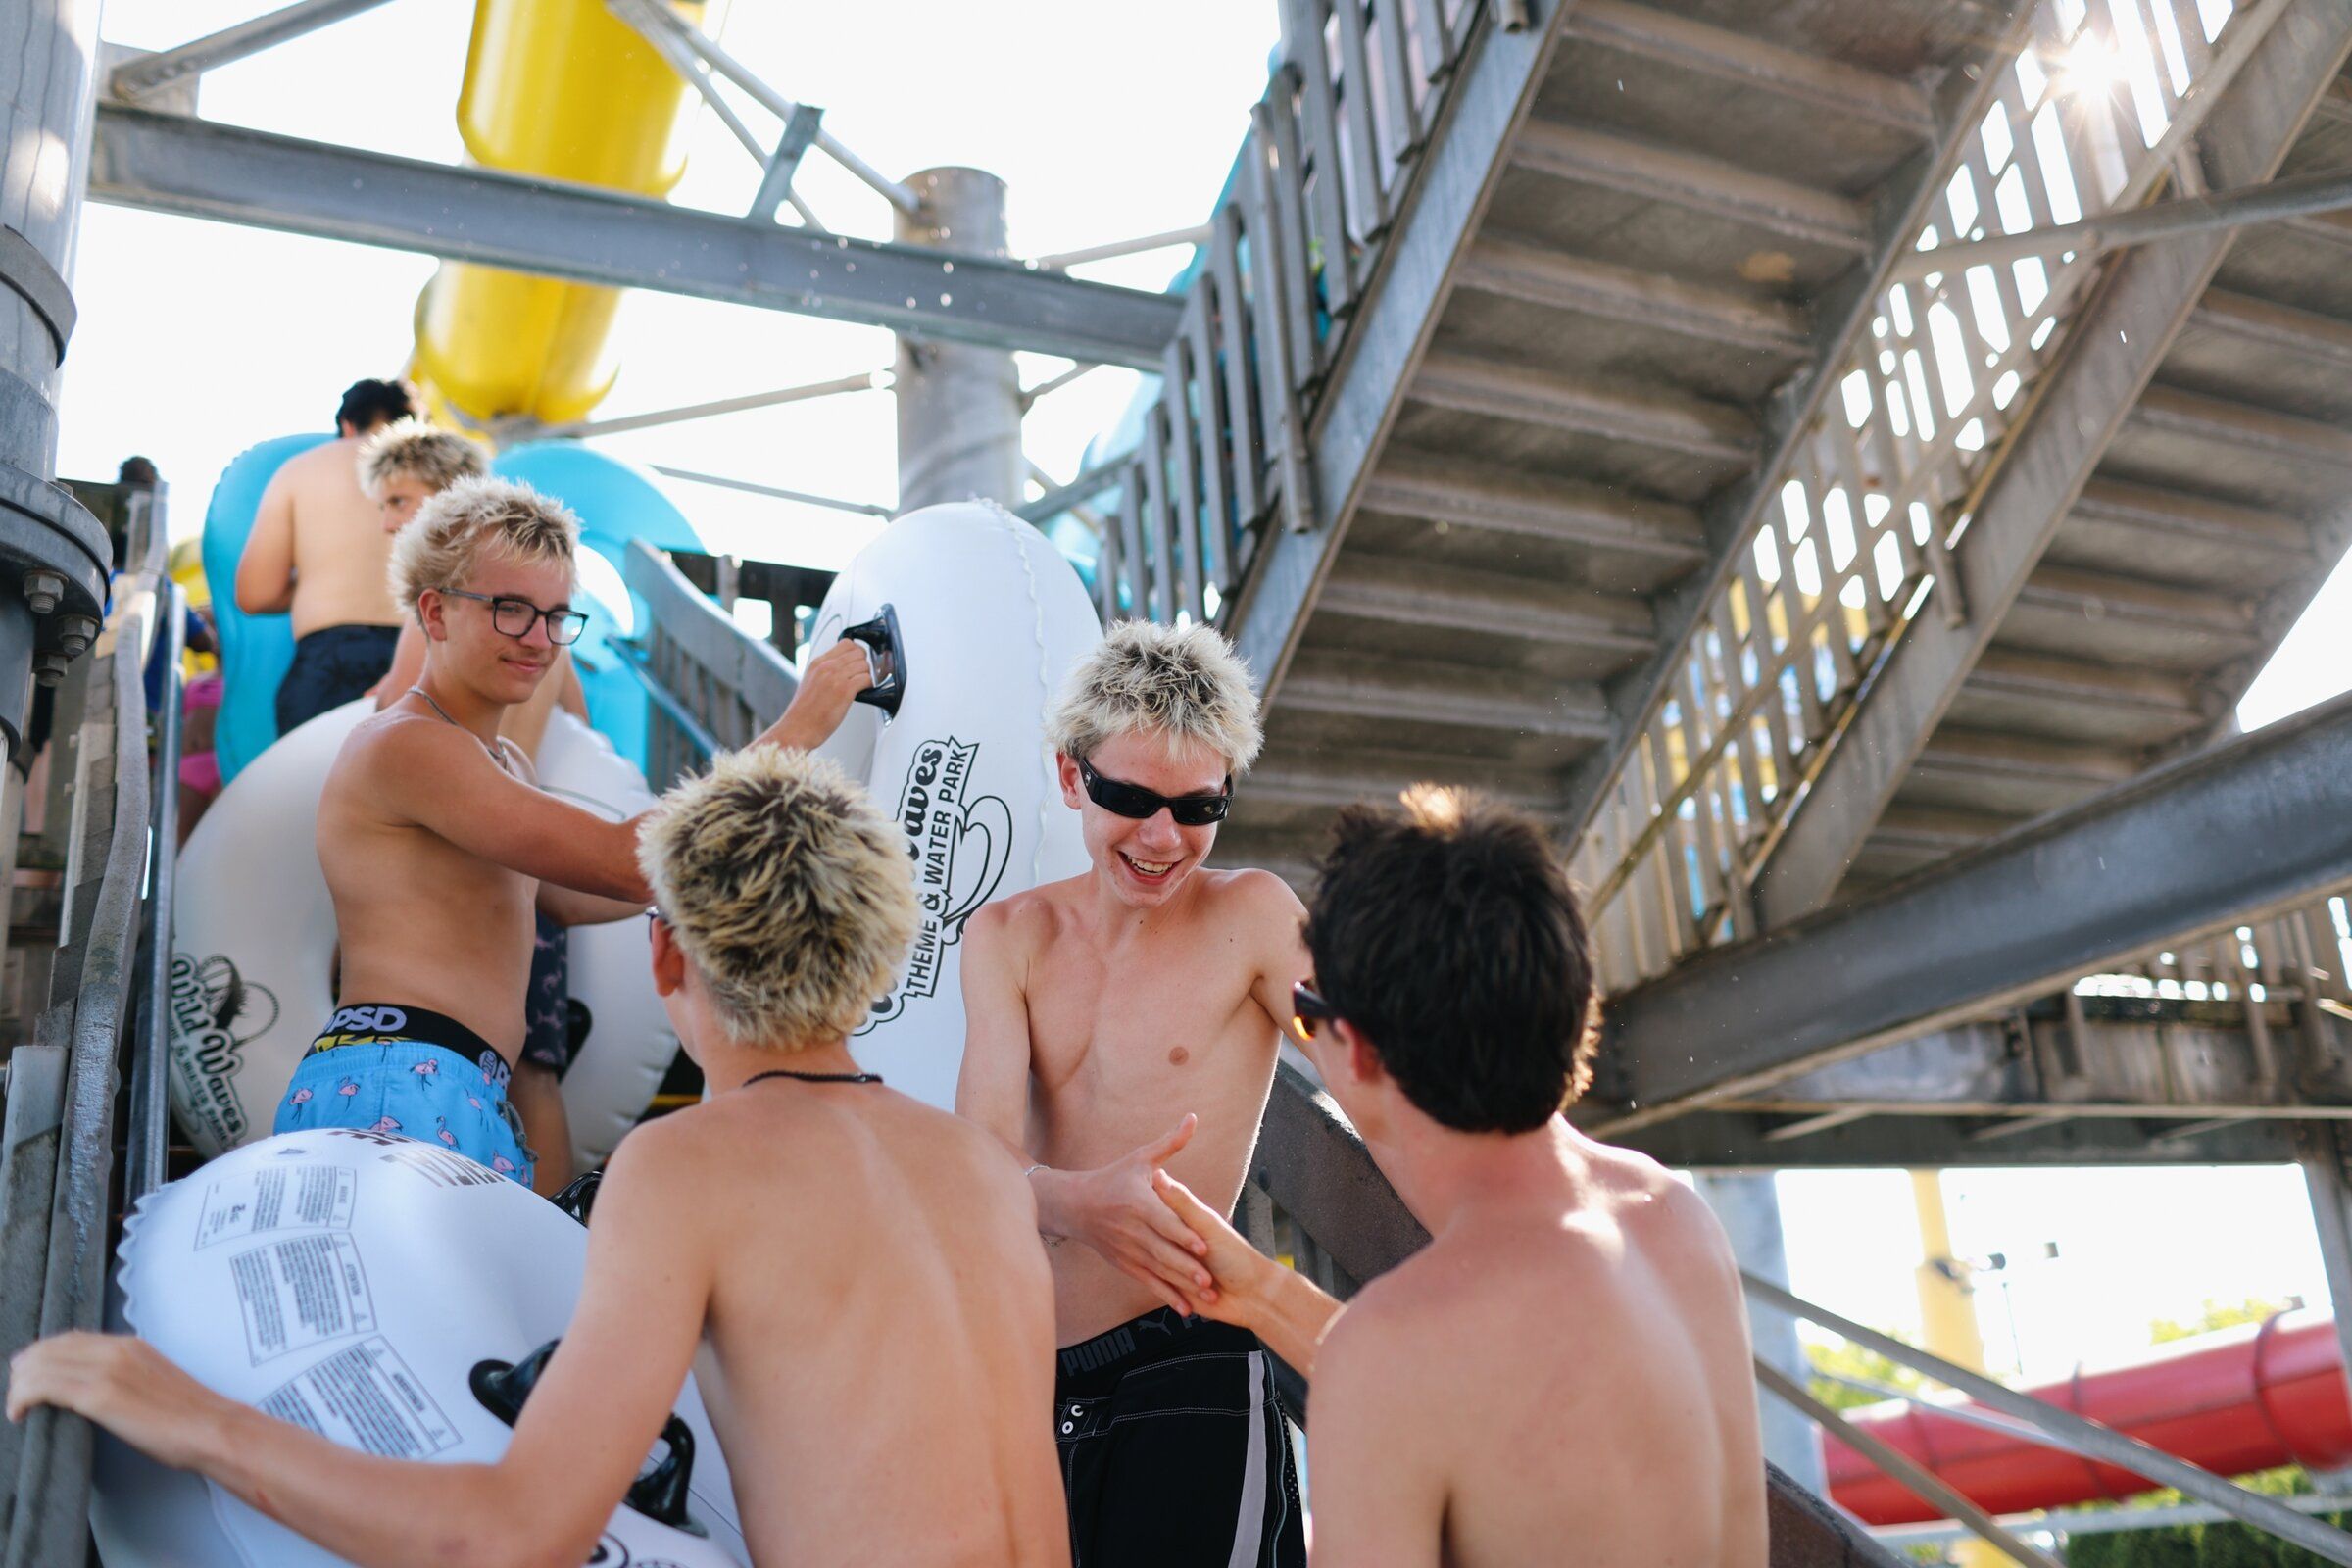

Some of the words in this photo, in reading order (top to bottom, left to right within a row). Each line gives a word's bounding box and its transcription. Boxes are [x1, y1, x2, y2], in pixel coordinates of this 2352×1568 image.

[904, 748, 942, 861] aves
[938, 748, 968, 803] PARK
[924, 810, 952, 884] WATER
[916, 891, 941, 911] &
[906, 919, 937, 989] THEME
[172, 960, 210, 1035] Wild
[196, 1034, 242, 1134] Waves
[325, 1005, 408, 1034] PSD
[1061, 1327, 1136, 1376] PUMA
